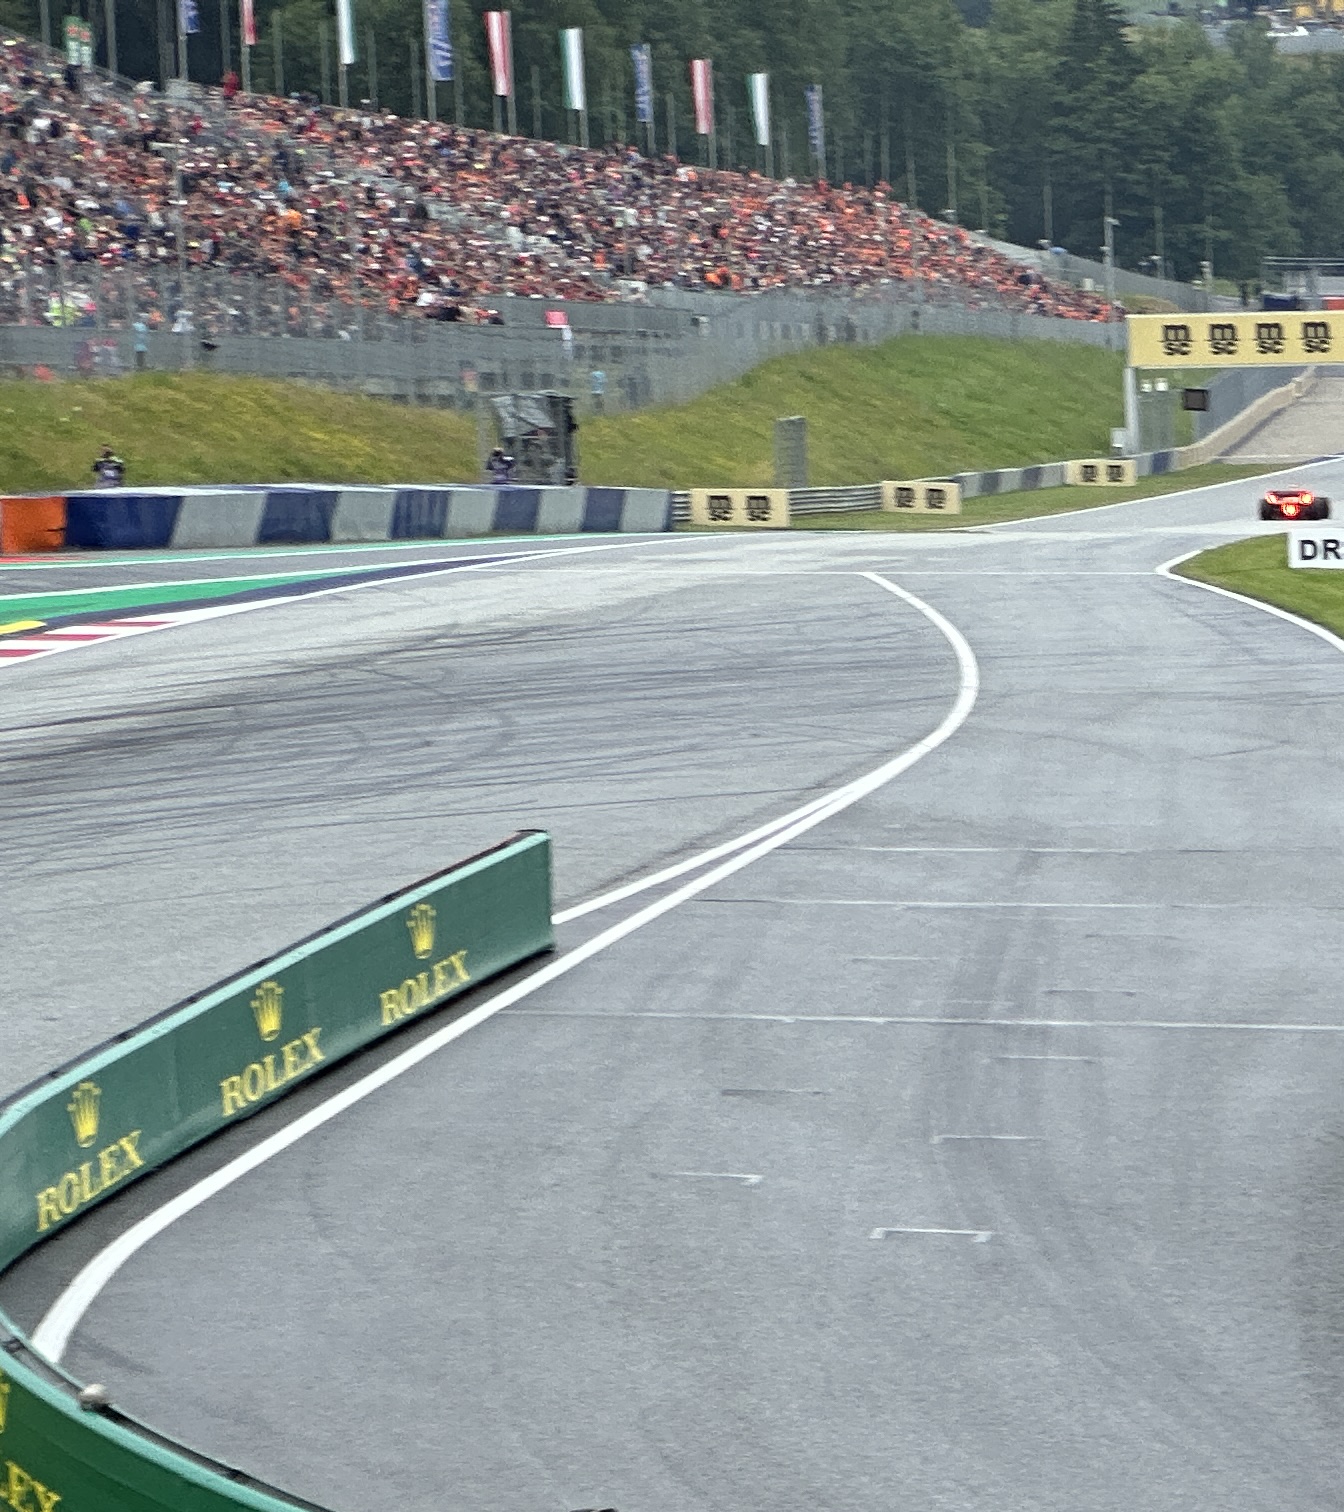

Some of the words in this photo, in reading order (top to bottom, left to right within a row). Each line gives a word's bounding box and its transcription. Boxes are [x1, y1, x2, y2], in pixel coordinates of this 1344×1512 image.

[379, 950, 471, 1026] ROLEX
[219, 1027, 326, 1117] ROLEX
[36, 1130, 145, 1233] ROLEX
